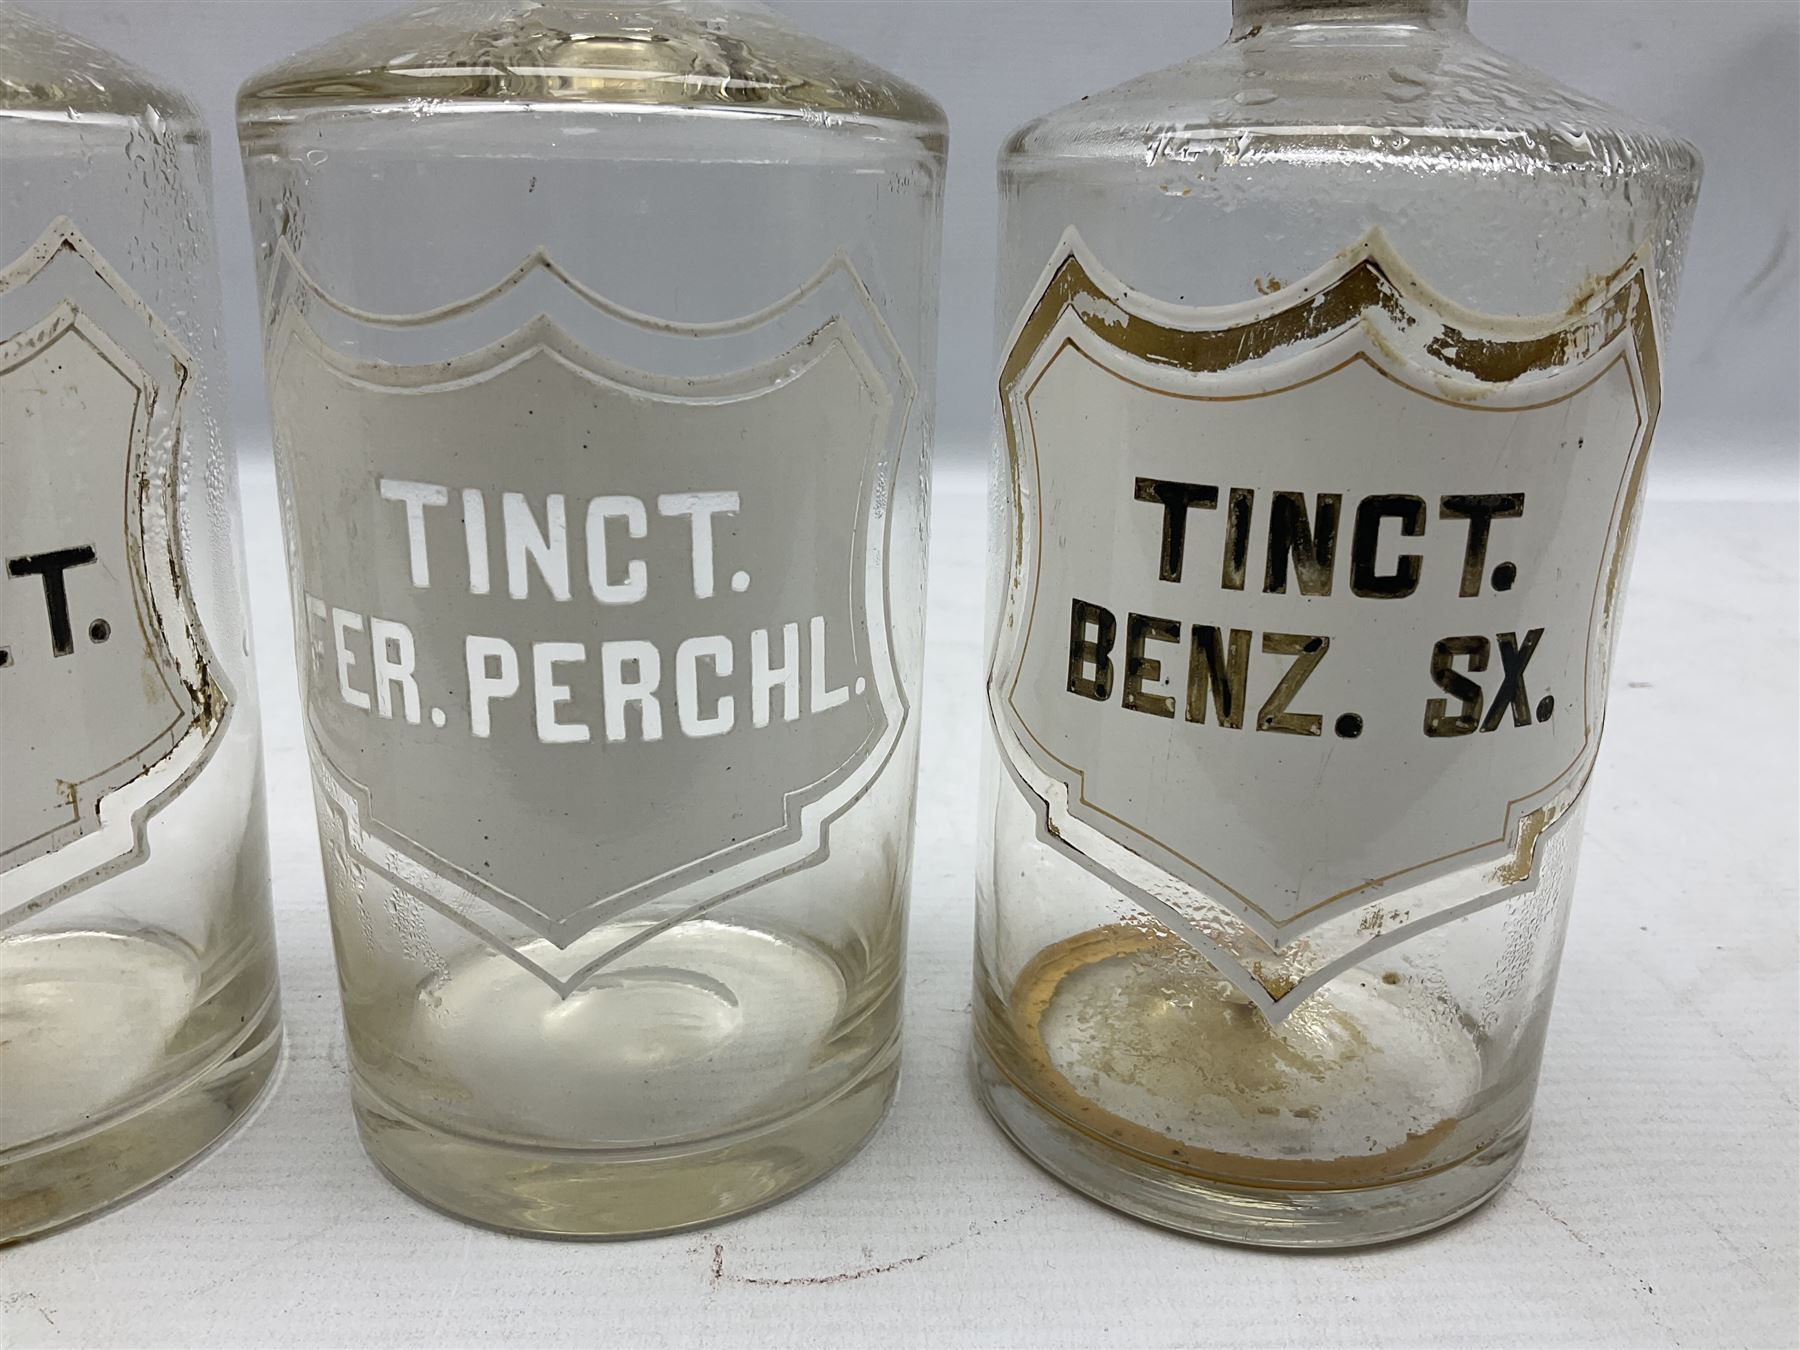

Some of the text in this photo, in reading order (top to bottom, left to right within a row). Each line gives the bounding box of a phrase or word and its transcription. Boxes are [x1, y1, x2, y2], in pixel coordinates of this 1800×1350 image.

[379, 478, 750, 604] TINCT.
[1133, 476, 1526, 599] TINCT.
[0, 541, 112, 668] T.
[1066, 597, 1555, 739] BENZ. SX.
[464, 615, 867, 743] PERCHL.
